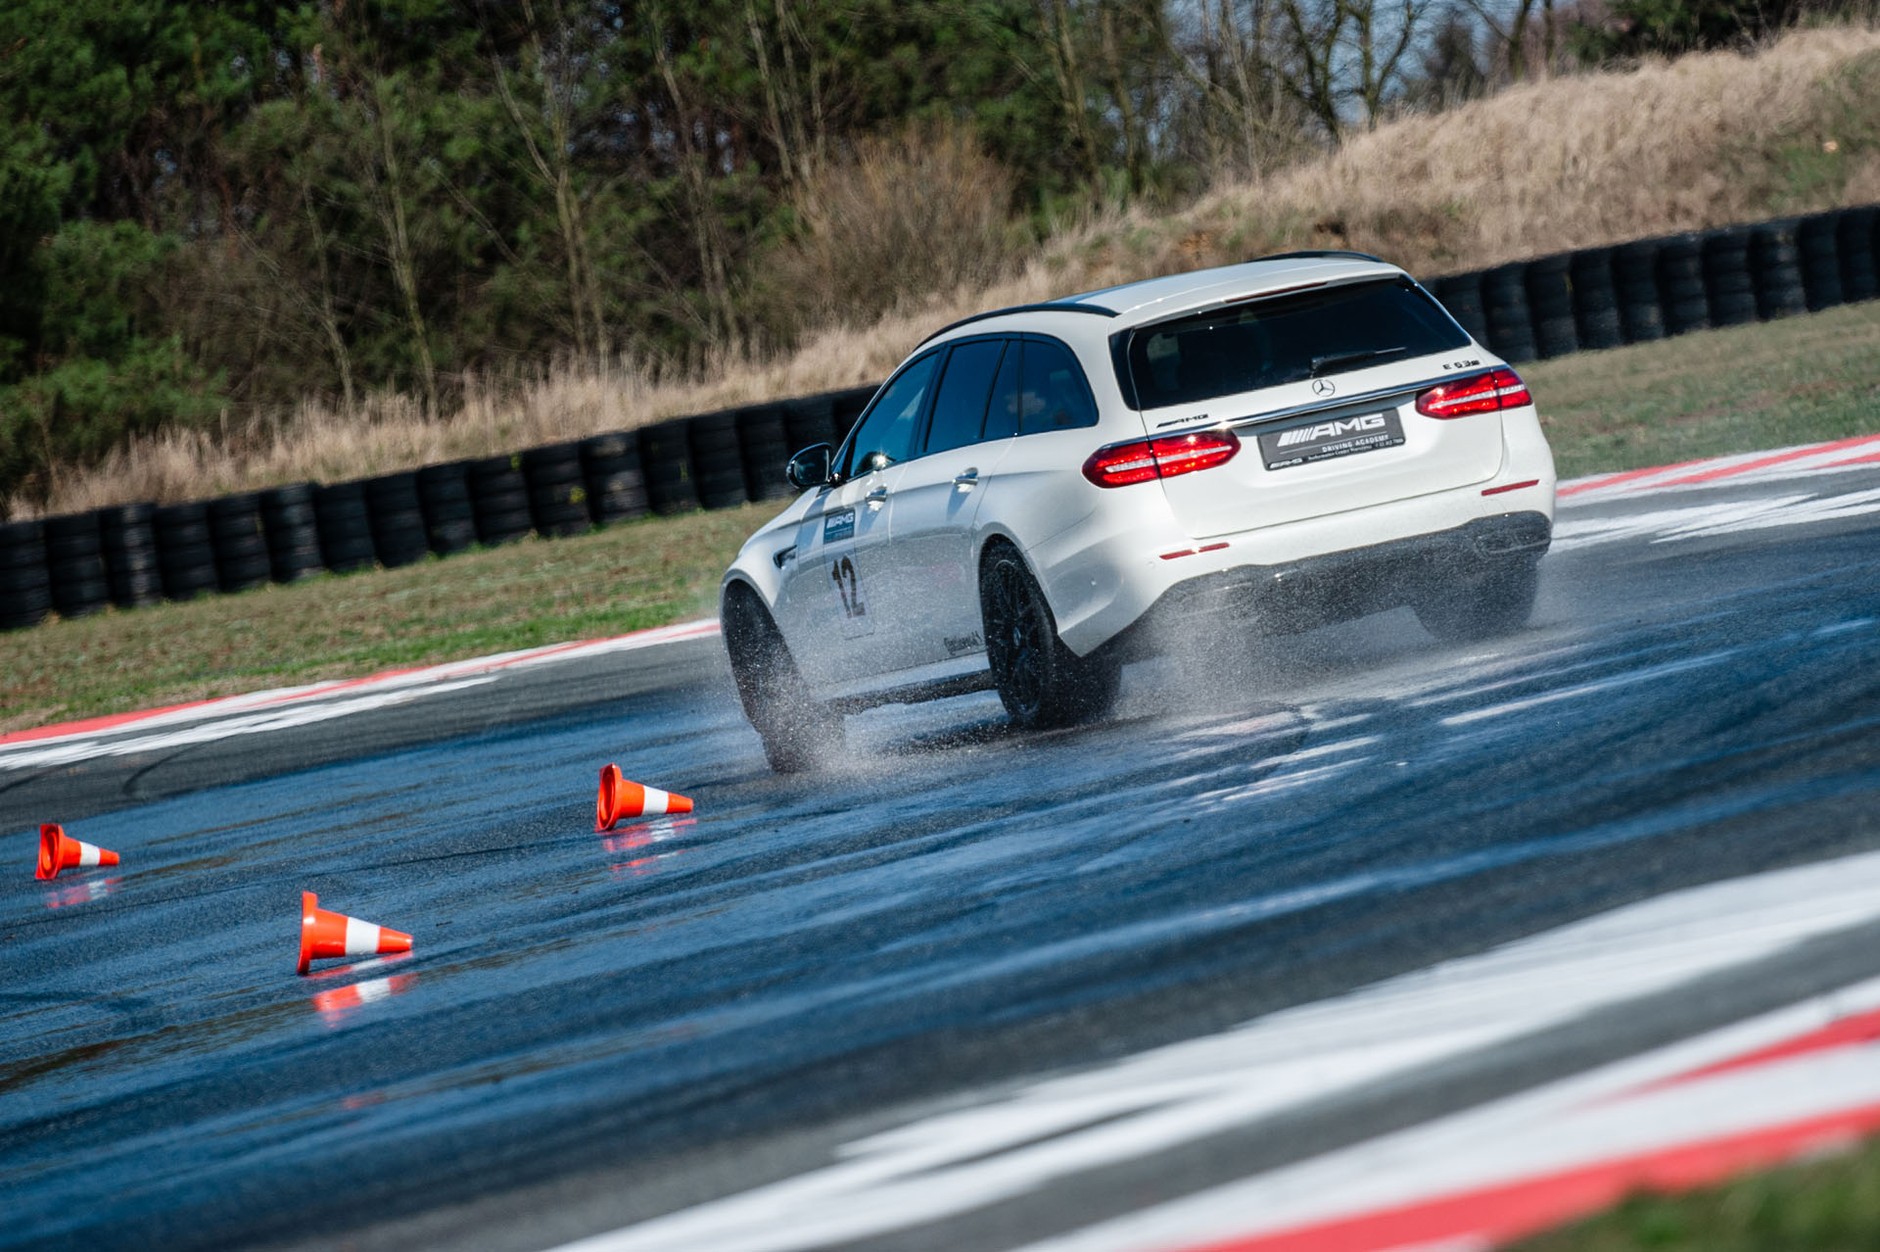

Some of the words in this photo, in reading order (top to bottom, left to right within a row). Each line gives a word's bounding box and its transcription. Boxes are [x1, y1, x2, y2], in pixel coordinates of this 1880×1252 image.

[1307, 413, 1387, 441] AMG
[1322, 441, 1353, 453] DRIVING
[1355, 434, 1389, 446] ACADEMY
[832, 555, 866, 619] 12
